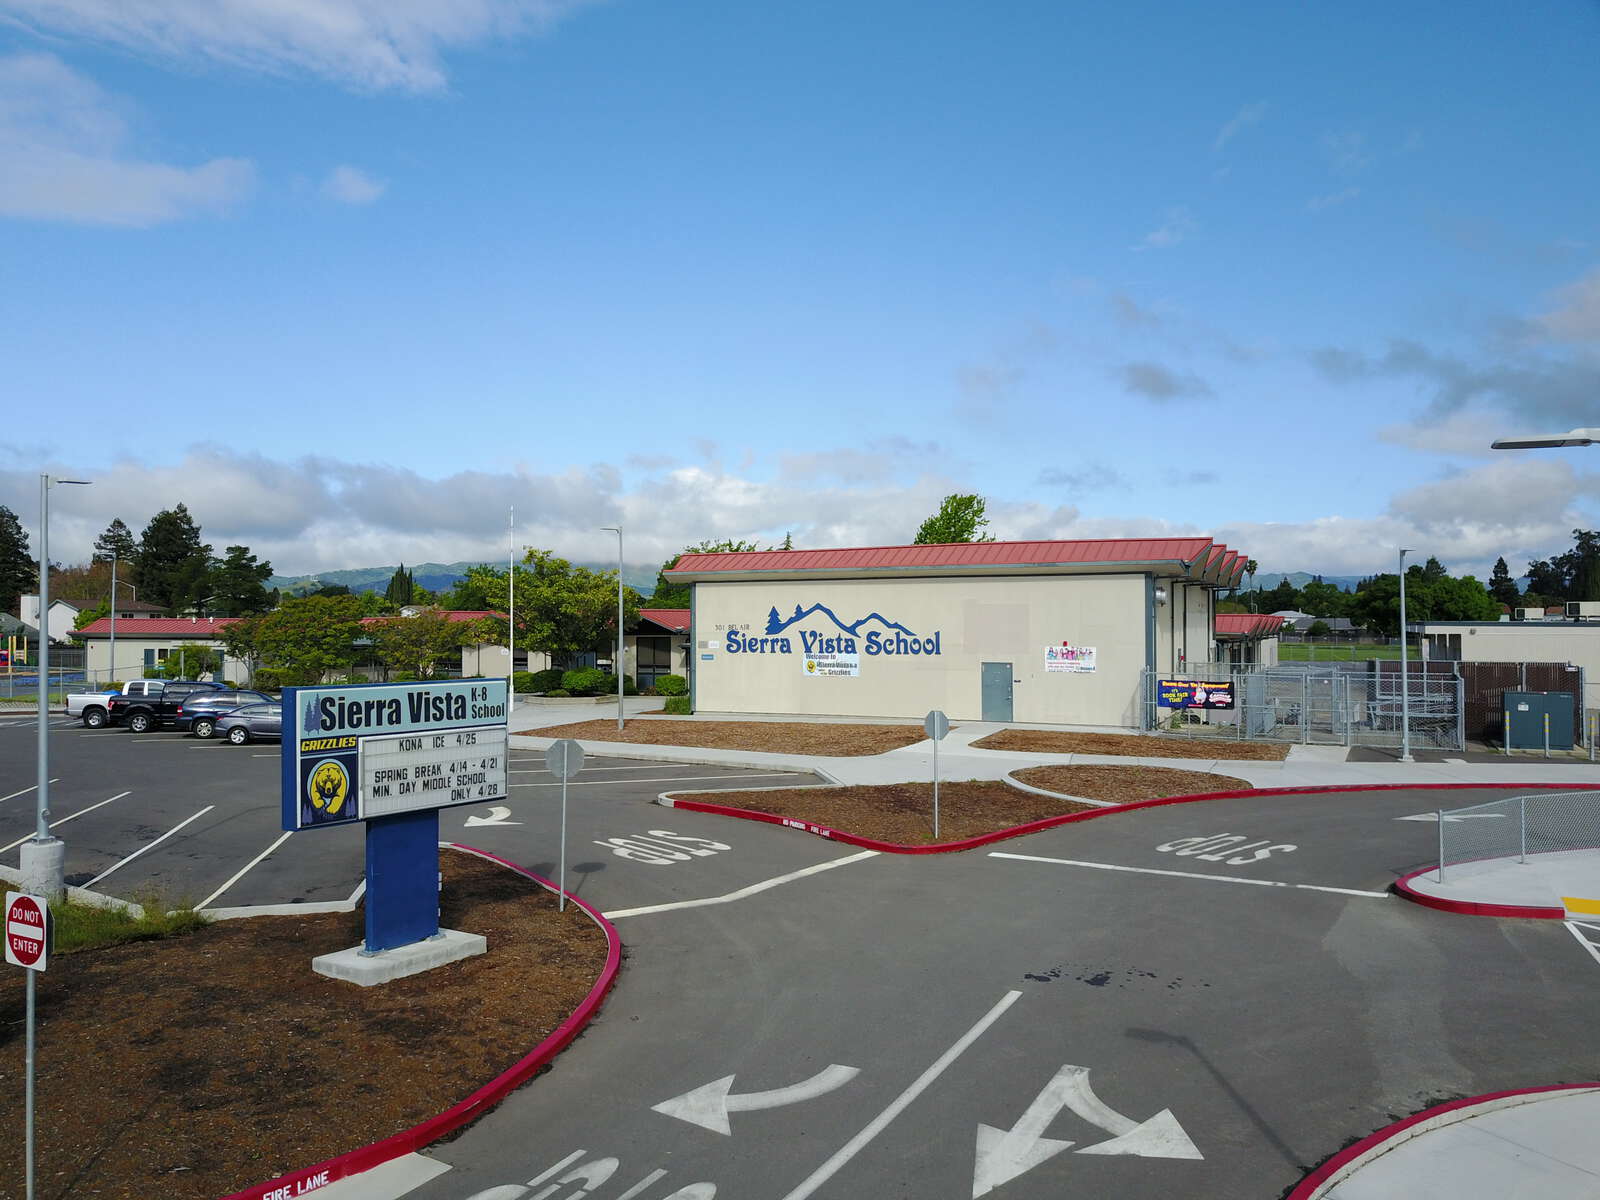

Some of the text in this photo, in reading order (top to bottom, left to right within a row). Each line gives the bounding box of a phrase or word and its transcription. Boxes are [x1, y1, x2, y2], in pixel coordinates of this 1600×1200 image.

[726, 630, 942, 656] Sierra Vista School
[471, 687, 488, 702] K-8
[320, 692, 467, 731] Sierra Vista
[471, 702, 505, 720] School
[301, 736, 356, 752] GRIZZLIES
[399, 733, 477, 752] KONA ICE 4/25
[374, 768, 408, 783] SPRING
[415, 763, 442, 779] BREAK
[449, 760, 468, 774] 4/14
[480, 757, 498, 770] 4/21
[372, 771, 487, 798] MIN. DAY MIDDLE SCHOOL
[451, 784, 498, 801] ONLY 4/28
[12, 907, 40, 924] DO NOT
[13, 938, 38, 955] ENTER
[263, 1170, 329, 1200] FIRE LANE
